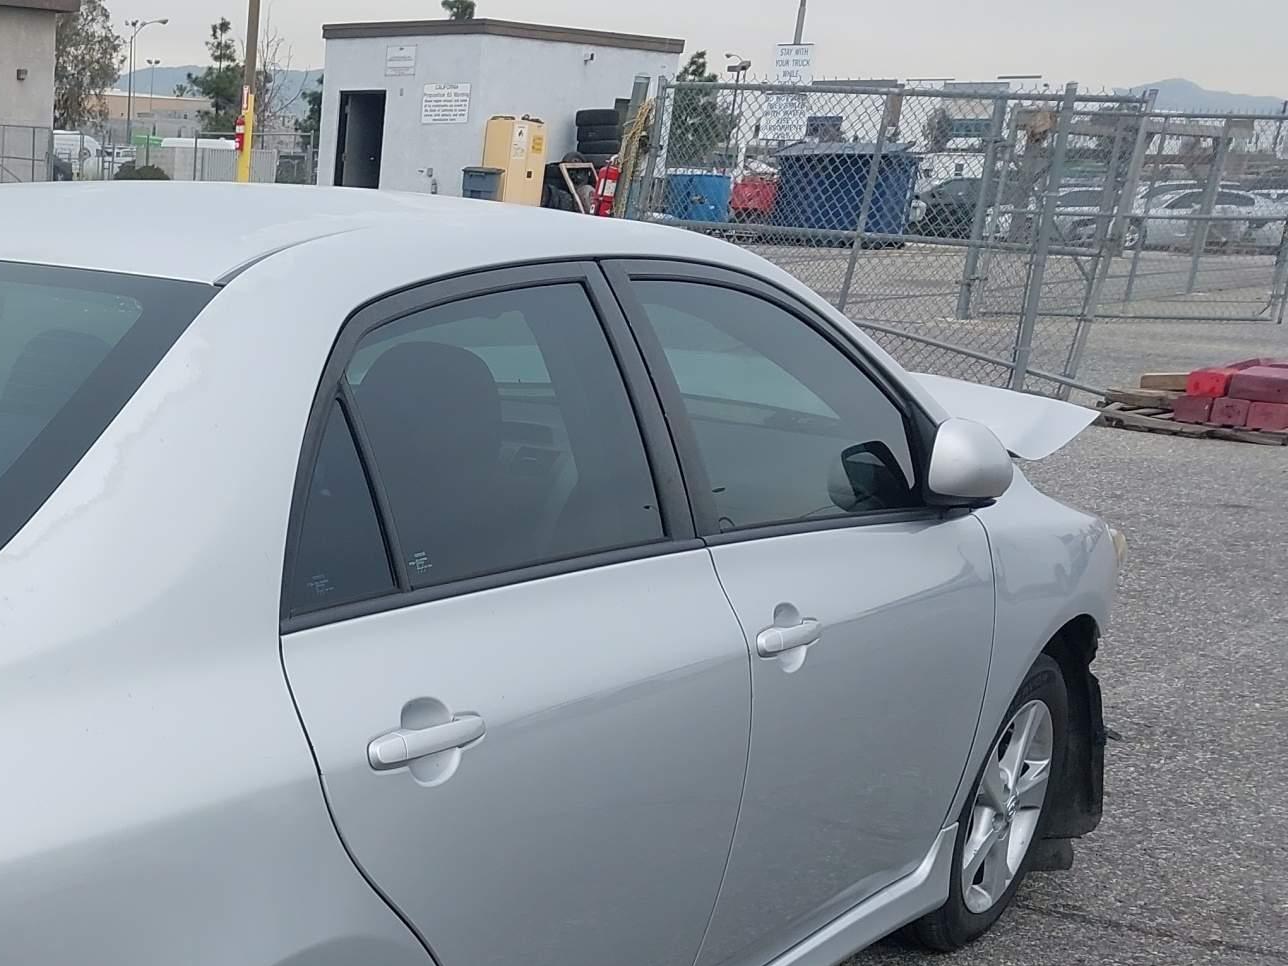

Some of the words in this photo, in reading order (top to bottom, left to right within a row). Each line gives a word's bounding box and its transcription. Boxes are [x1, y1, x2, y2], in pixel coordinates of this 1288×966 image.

[780, 48, 793, 56] STAY
[795, 47, 809, 56] WITH
[776, 59, 789, 67] YOUR
[792, 58, 810, 67] TRUCK
